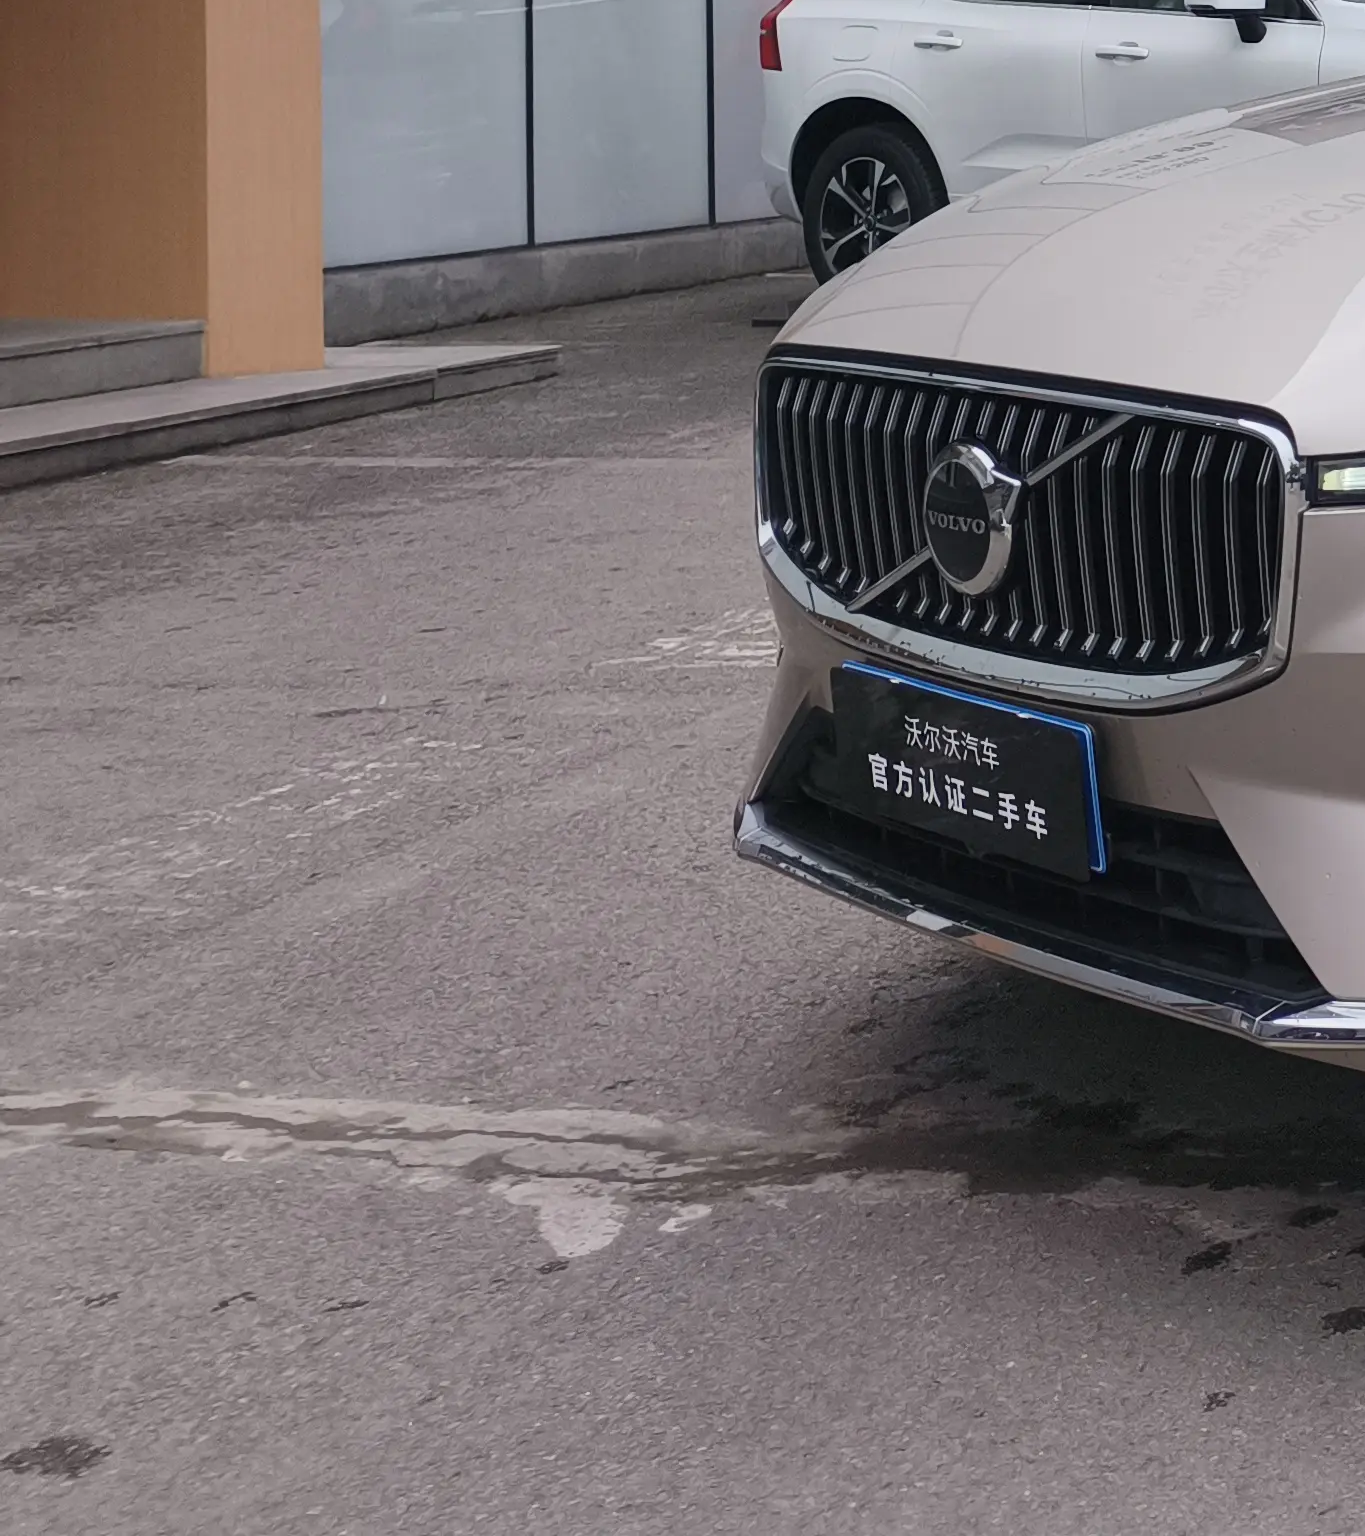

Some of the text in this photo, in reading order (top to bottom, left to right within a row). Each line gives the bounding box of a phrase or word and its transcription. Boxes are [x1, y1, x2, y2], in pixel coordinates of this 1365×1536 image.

[927, 509, 986, 535] VOLVO
[904, 715, 1000, 770] 沃尔沃汽车
[867, 752, 1048, 840] 官方认证二手车
